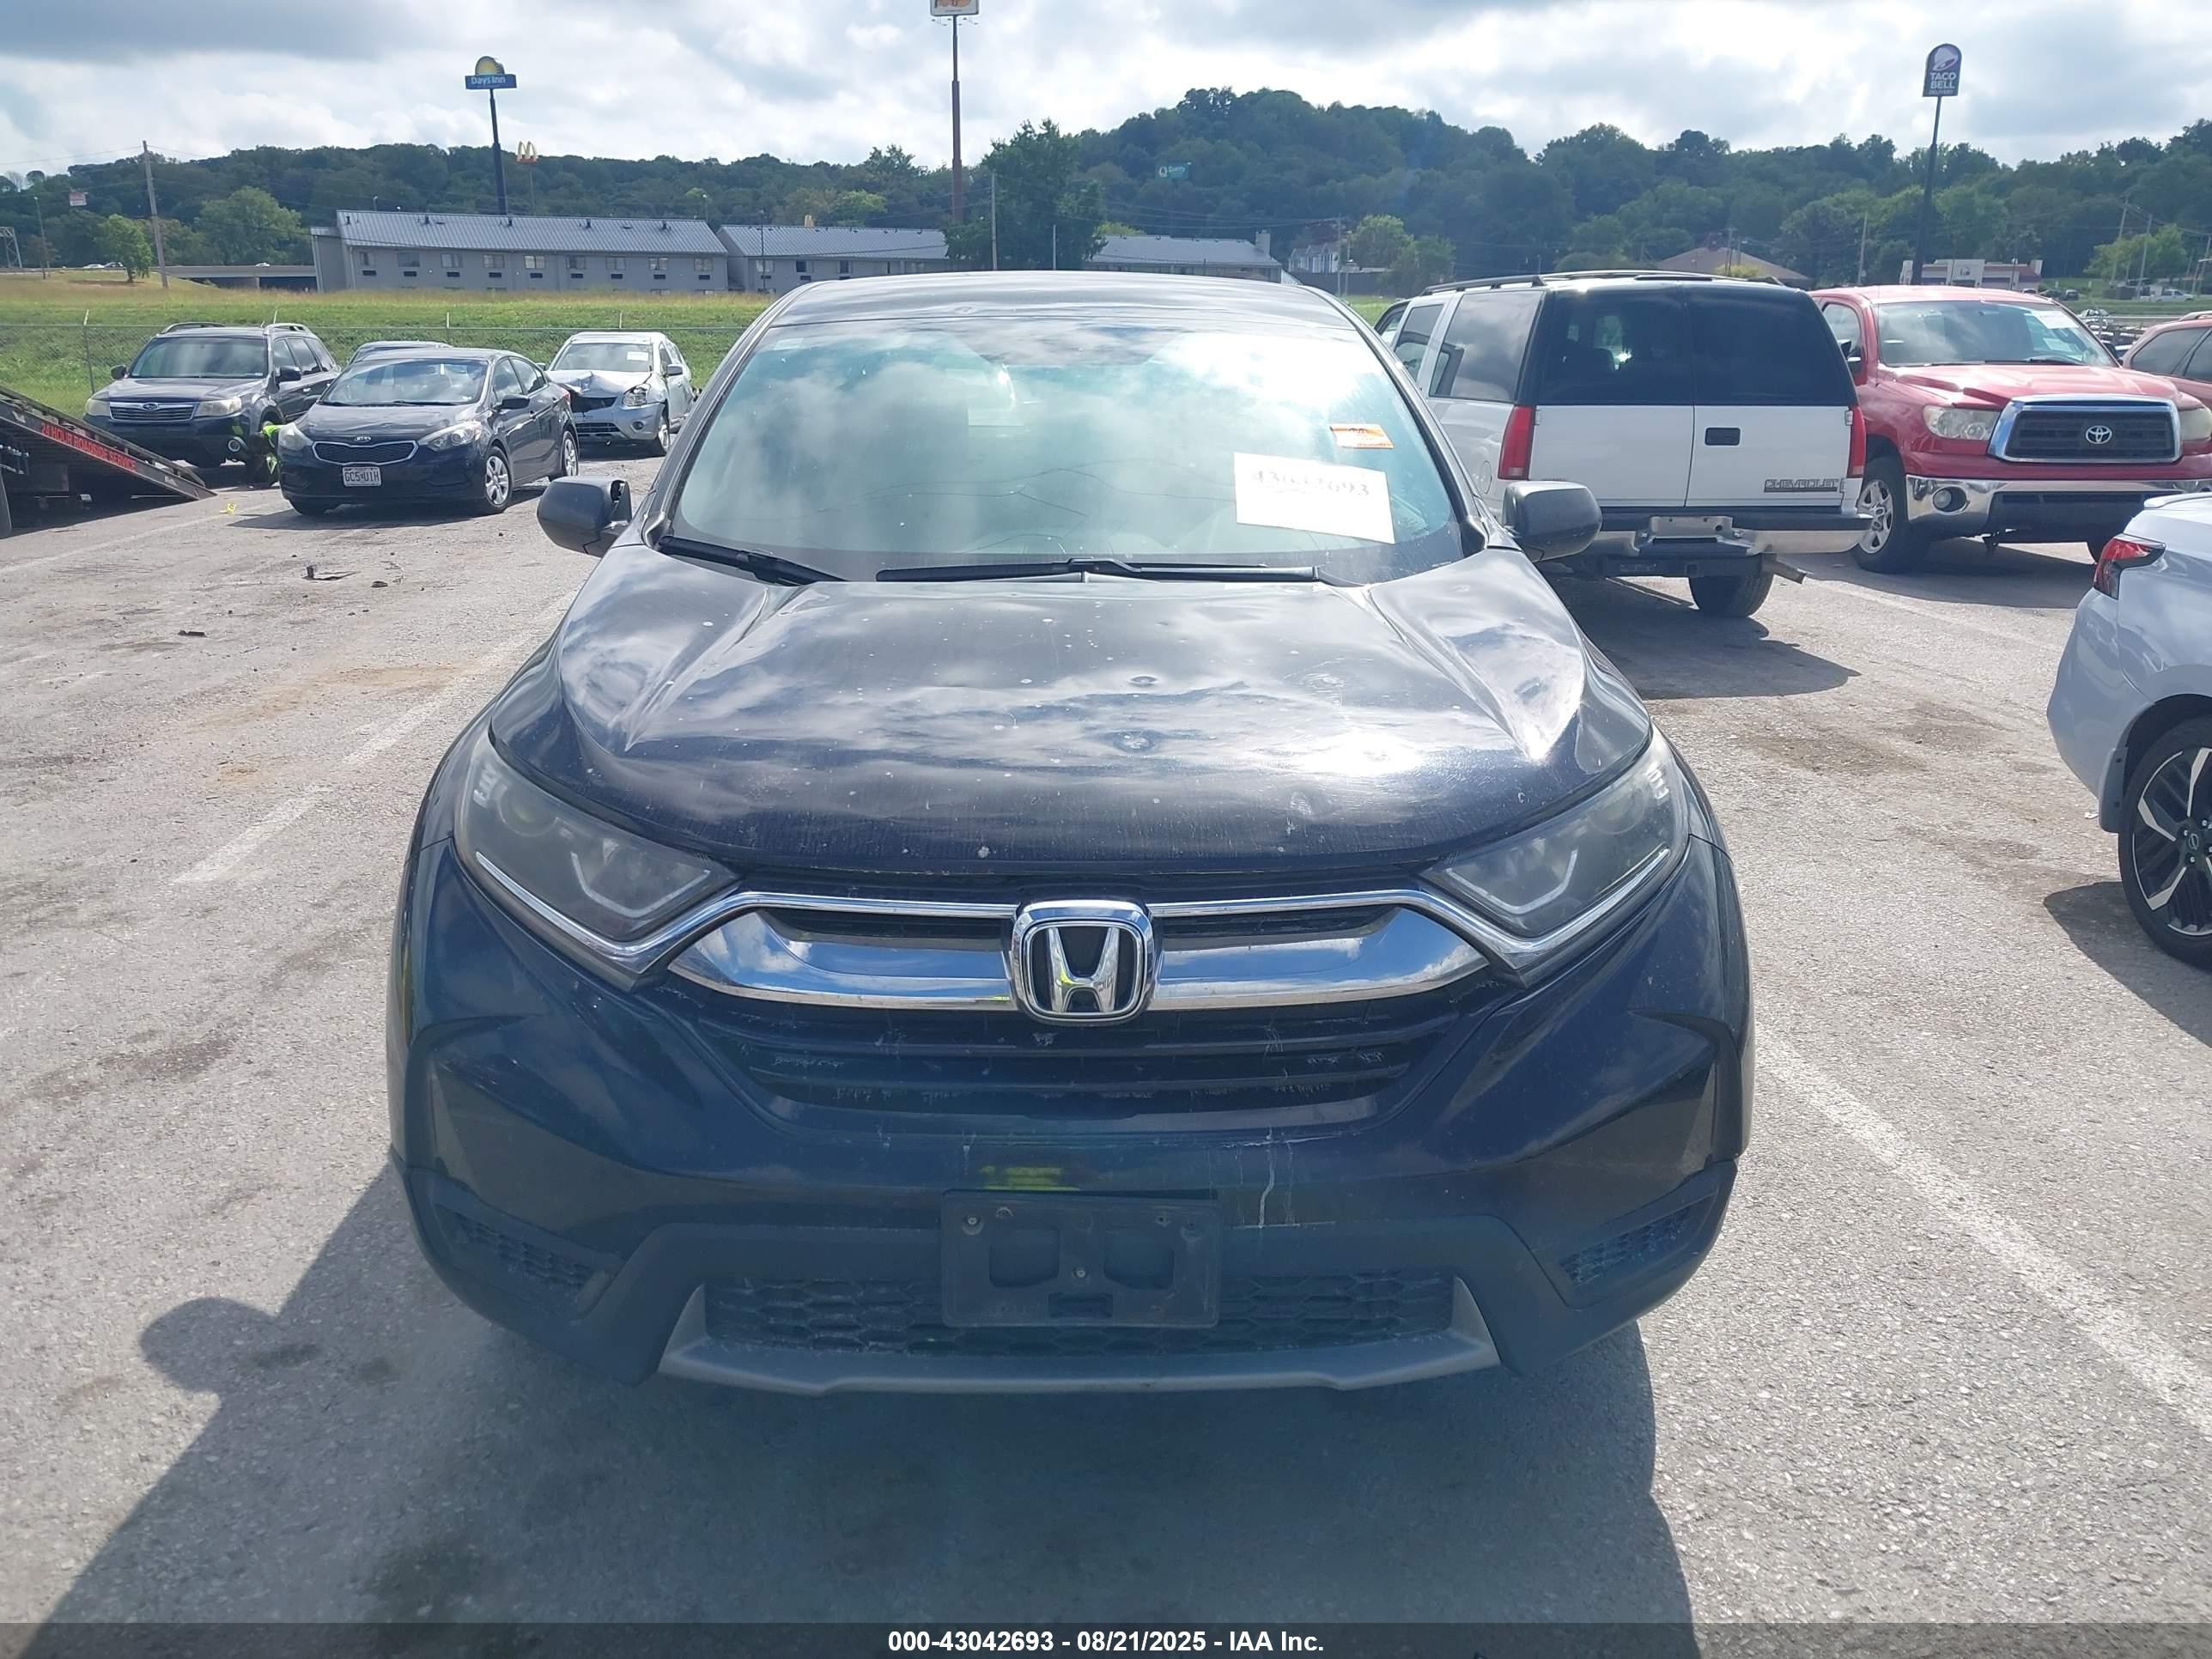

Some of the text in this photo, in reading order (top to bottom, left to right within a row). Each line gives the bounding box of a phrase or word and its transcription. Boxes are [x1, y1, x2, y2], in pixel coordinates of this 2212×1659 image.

[1929, 72, 1957, 81] TACO
[1929, 81, 1955, 89] BELL
[41, 422, 137, 472] 24 HOUR ROADSIDE SERVICE
